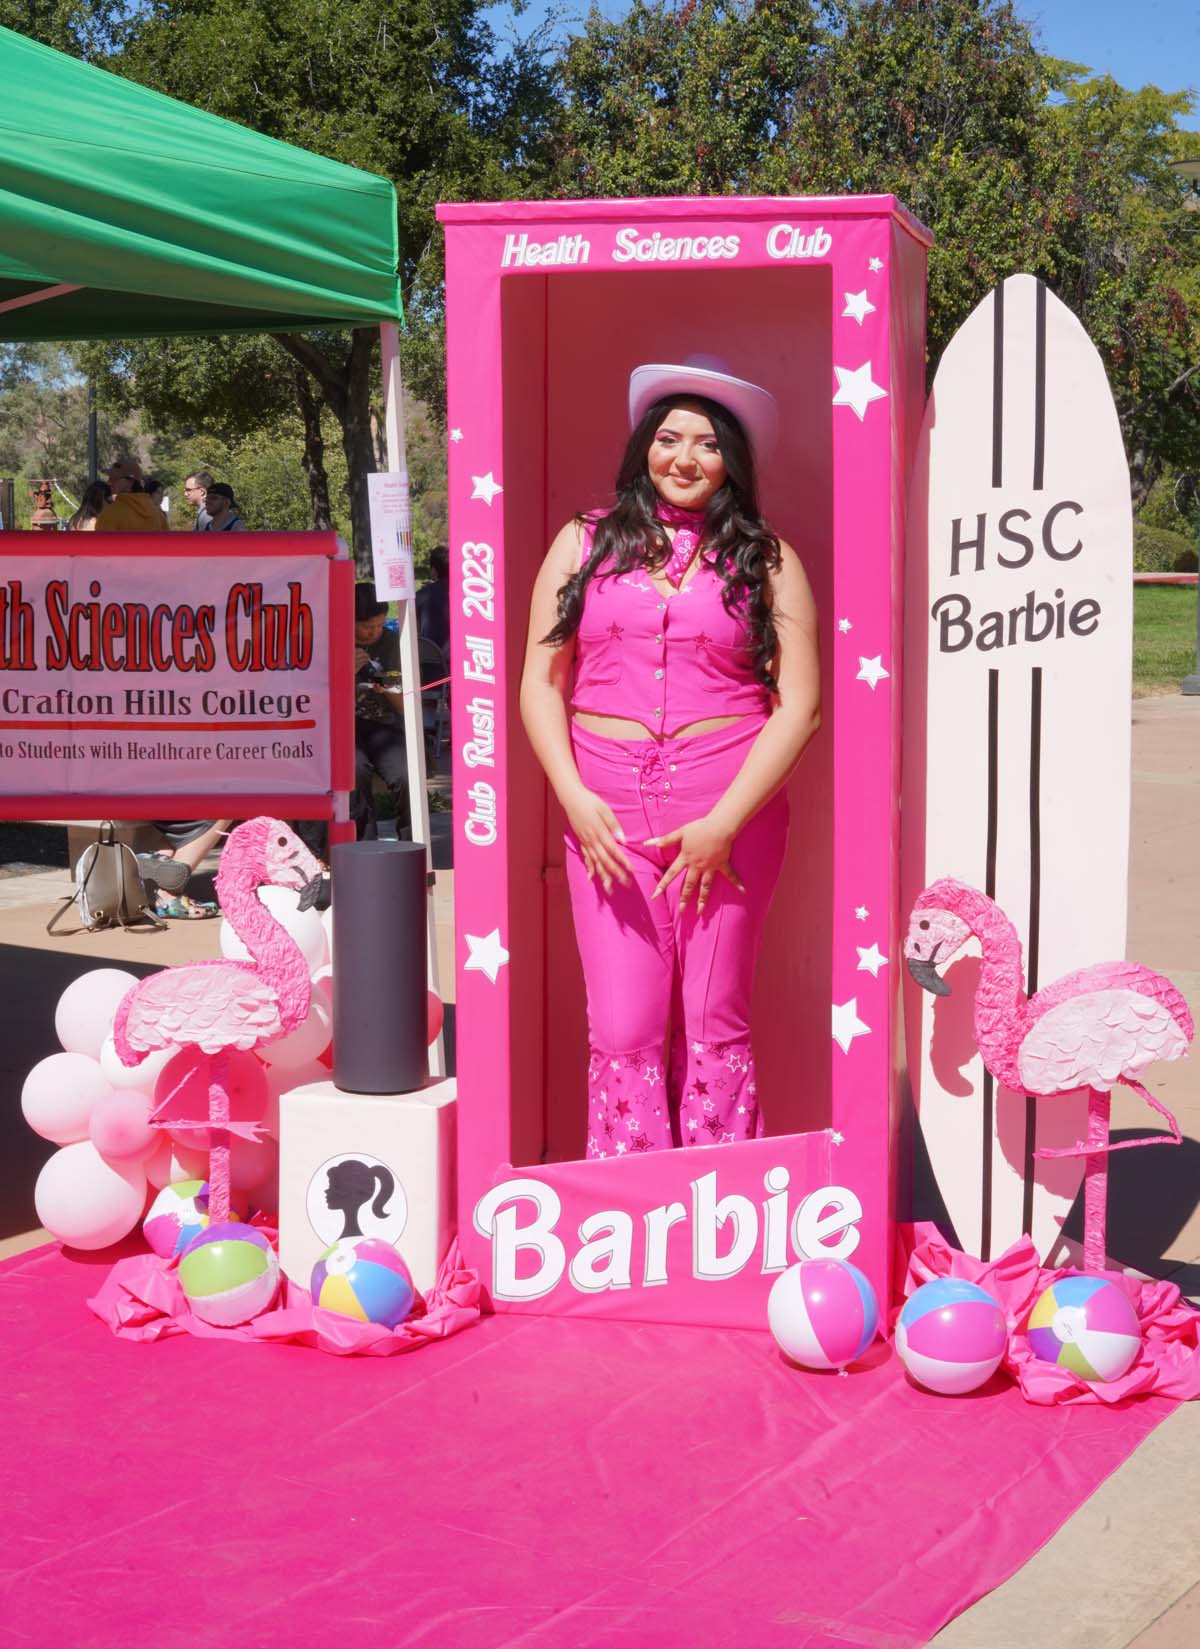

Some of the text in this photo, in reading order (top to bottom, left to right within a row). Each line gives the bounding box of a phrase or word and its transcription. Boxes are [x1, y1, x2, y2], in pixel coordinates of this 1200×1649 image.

[501, 224, 833, 267] Health Sciences Club
[950, 500, 1084, 577] HSC
[45, 580, 216, 672] Sciences
[225, 582, 314, 672] Club
[931, 588, 1102, 653] Barbie
[3, 688, 312, 718] Crafton Hills College
[462, 541, 497, 847] Club Rush Fall 2023
[18, 742, 85, 759] Students
[90, 742, 122, 759] with
[127, 743, 211, 760] Healthcare
[216, 743, 267, 760] Career
[272, 742, 313, 759] Goals
[473, 1166, 863, 1302] Barbie
